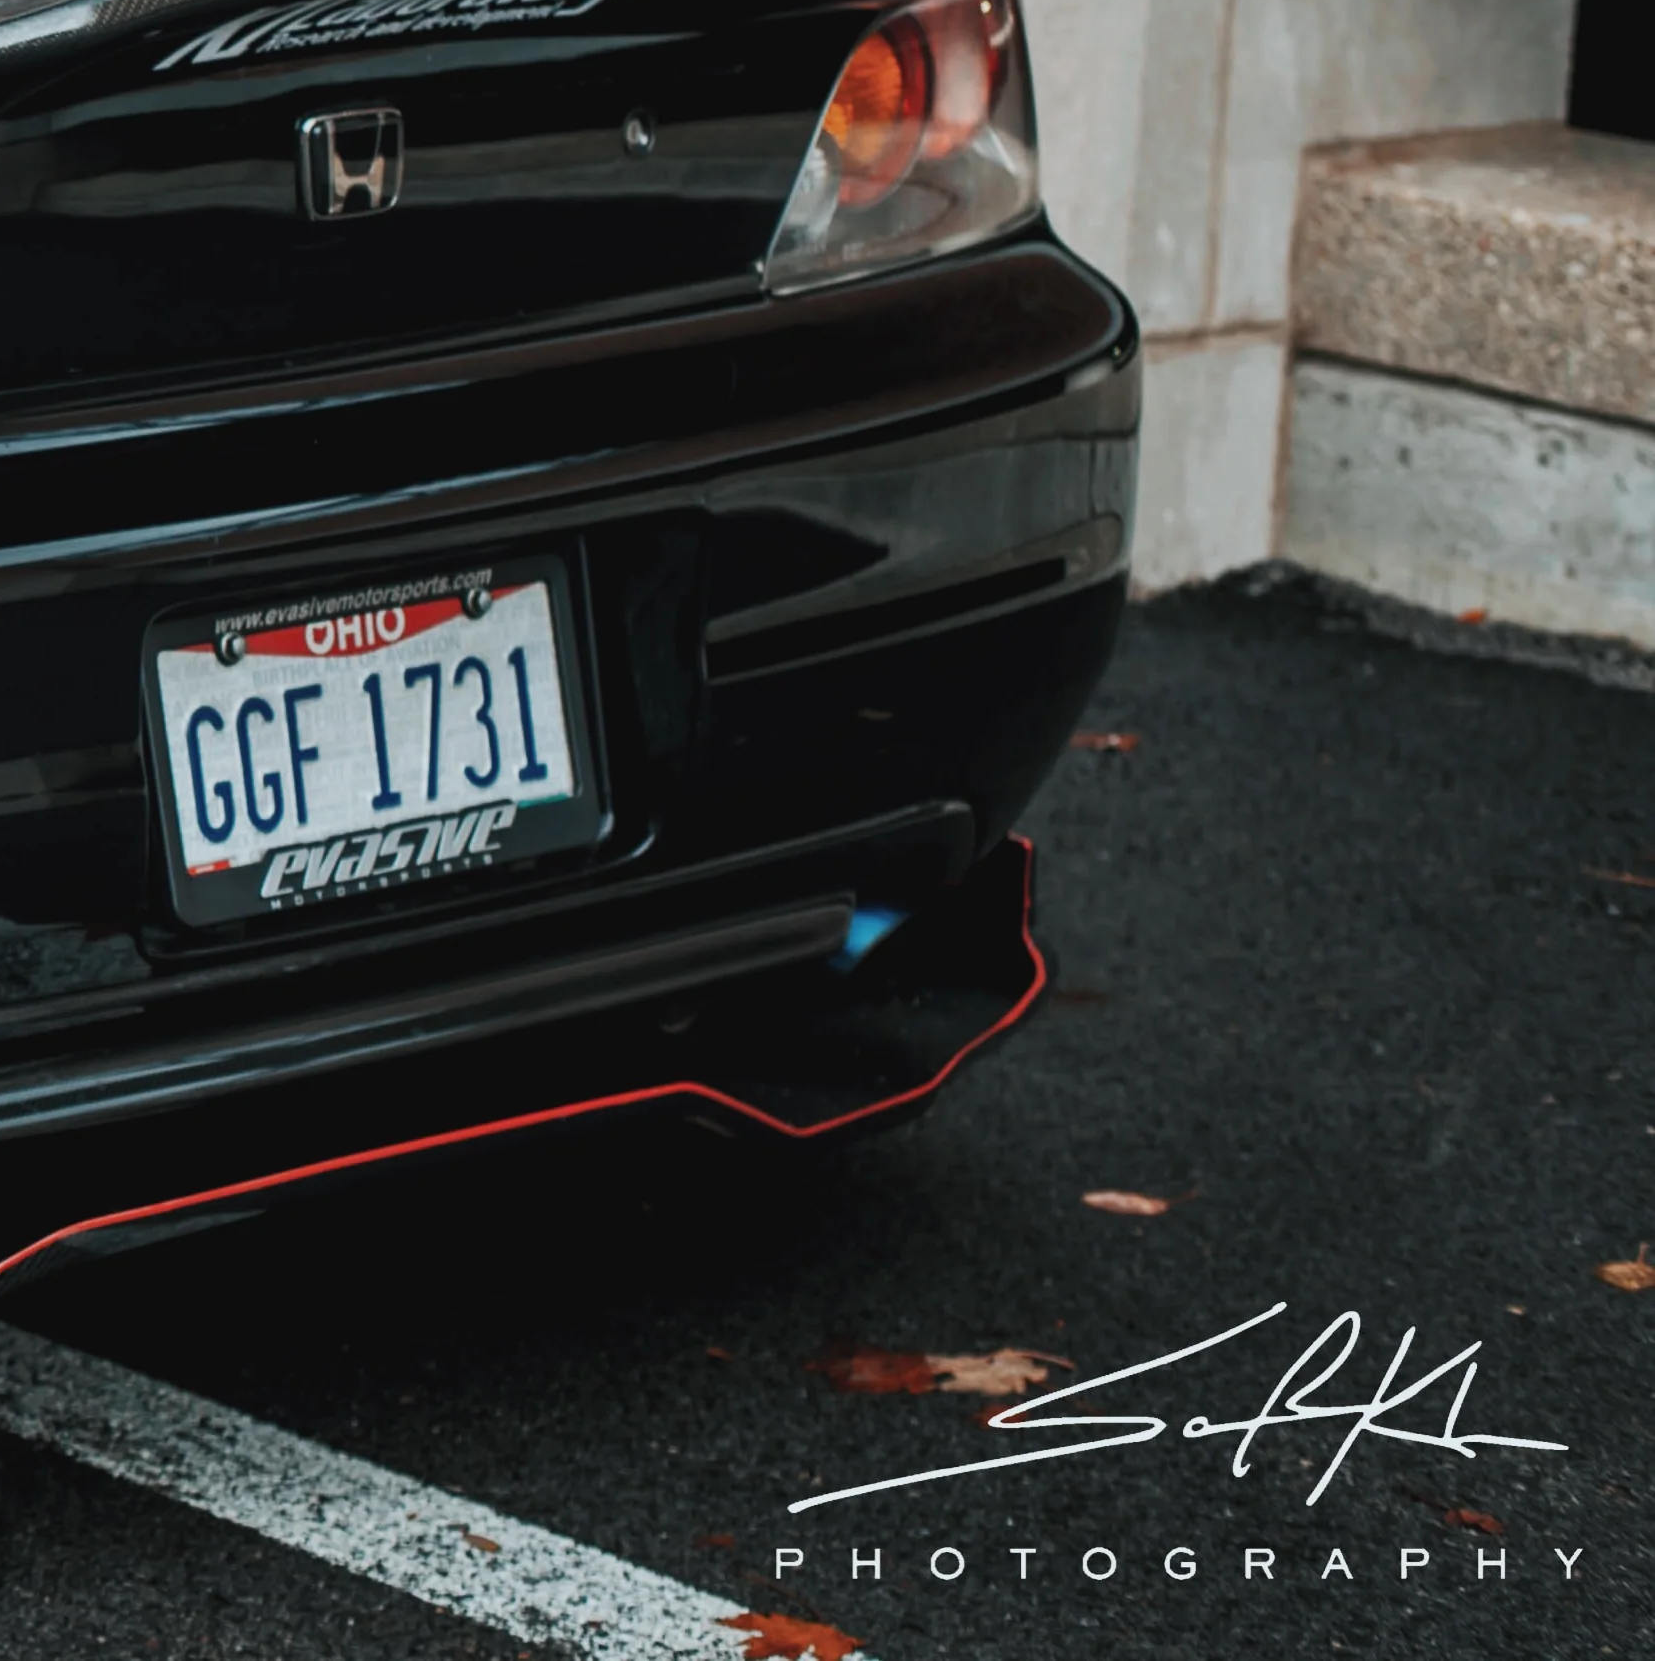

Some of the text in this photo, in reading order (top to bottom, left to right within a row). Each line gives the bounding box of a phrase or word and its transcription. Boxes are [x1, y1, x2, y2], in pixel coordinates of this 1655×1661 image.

[214, 567, 493, 635] www.evasivemotorsports.com
[304, 607, 406, 656] OHIO
[186, 646, 549, 844] GGF 1731
[270, 853, 494, 911] MOTORSPORTS
